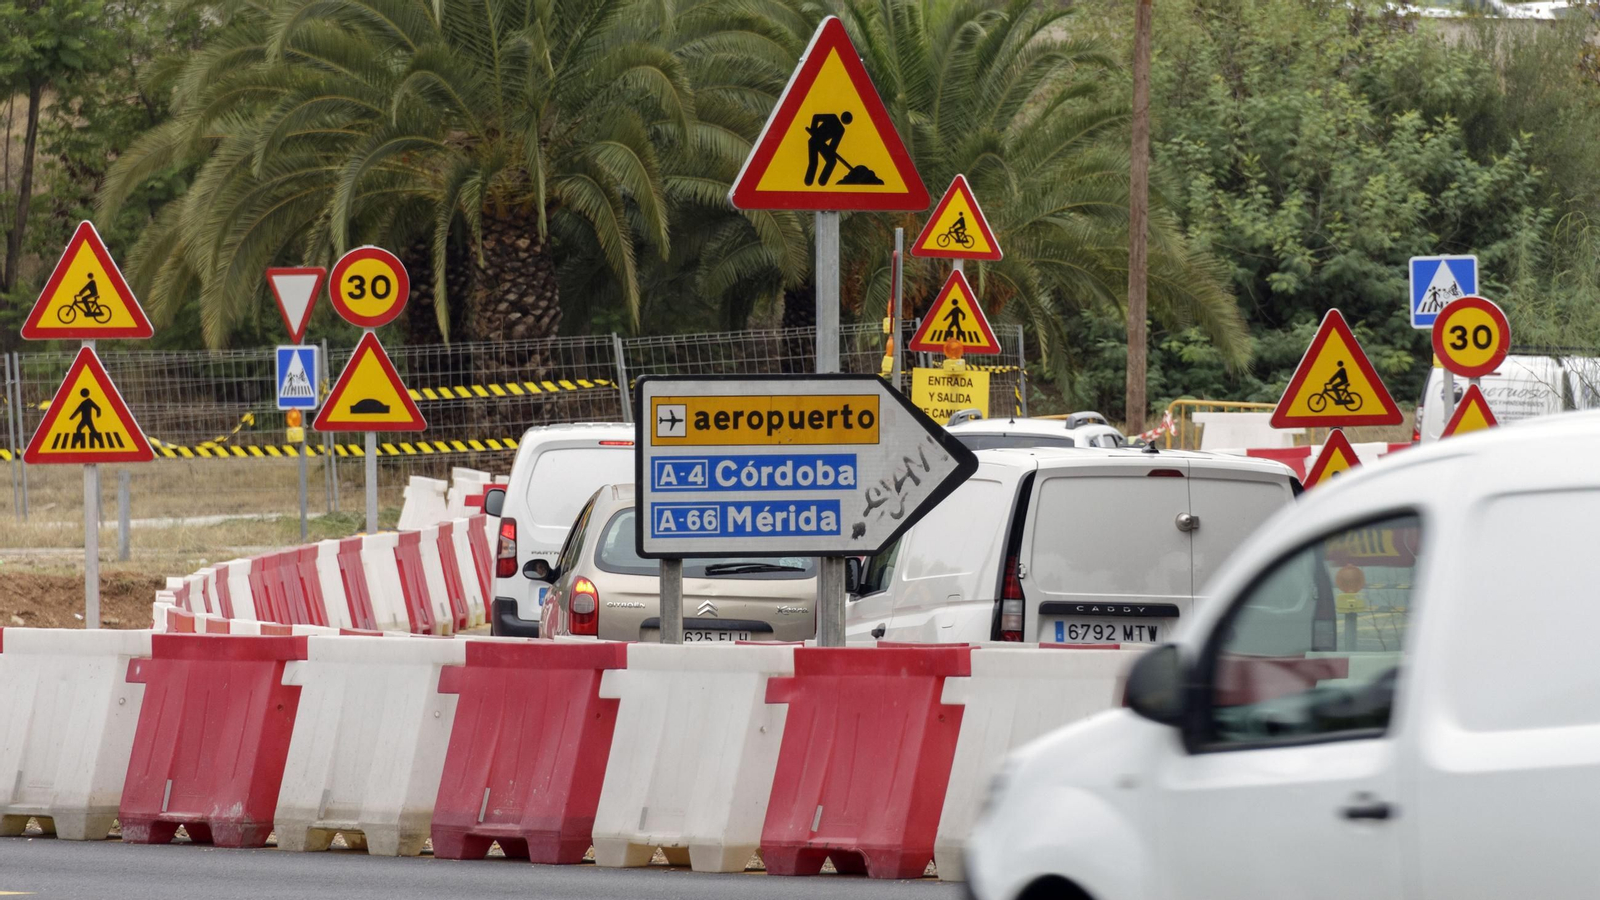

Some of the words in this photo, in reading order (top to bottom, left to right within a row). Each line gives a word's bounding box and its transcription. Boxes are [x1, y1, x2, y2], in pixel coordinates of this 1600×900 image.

[347, 275, 391, 300] 30
[1449, 324, 1492, 350] 30
[928, 376, 973, 387] ENTRADA
[929, 392, 935, 401] Y
[937, 392, 971, 403] SALIDA
[694, 404, 875, 436] aeropuerto
[659, 464, 705, 486] A-4
[715, 460, 856, 487] Córdoba
[658, 510, 718, 531] A-66
[727, 505, 838, 532] Mérida
[1076, 605, 1145, 613] CADDY
[684, 631, 713, 642] 625
[1068, 624, 1116, 641] 6792
[1123, 625, 1158, 642] MTW
